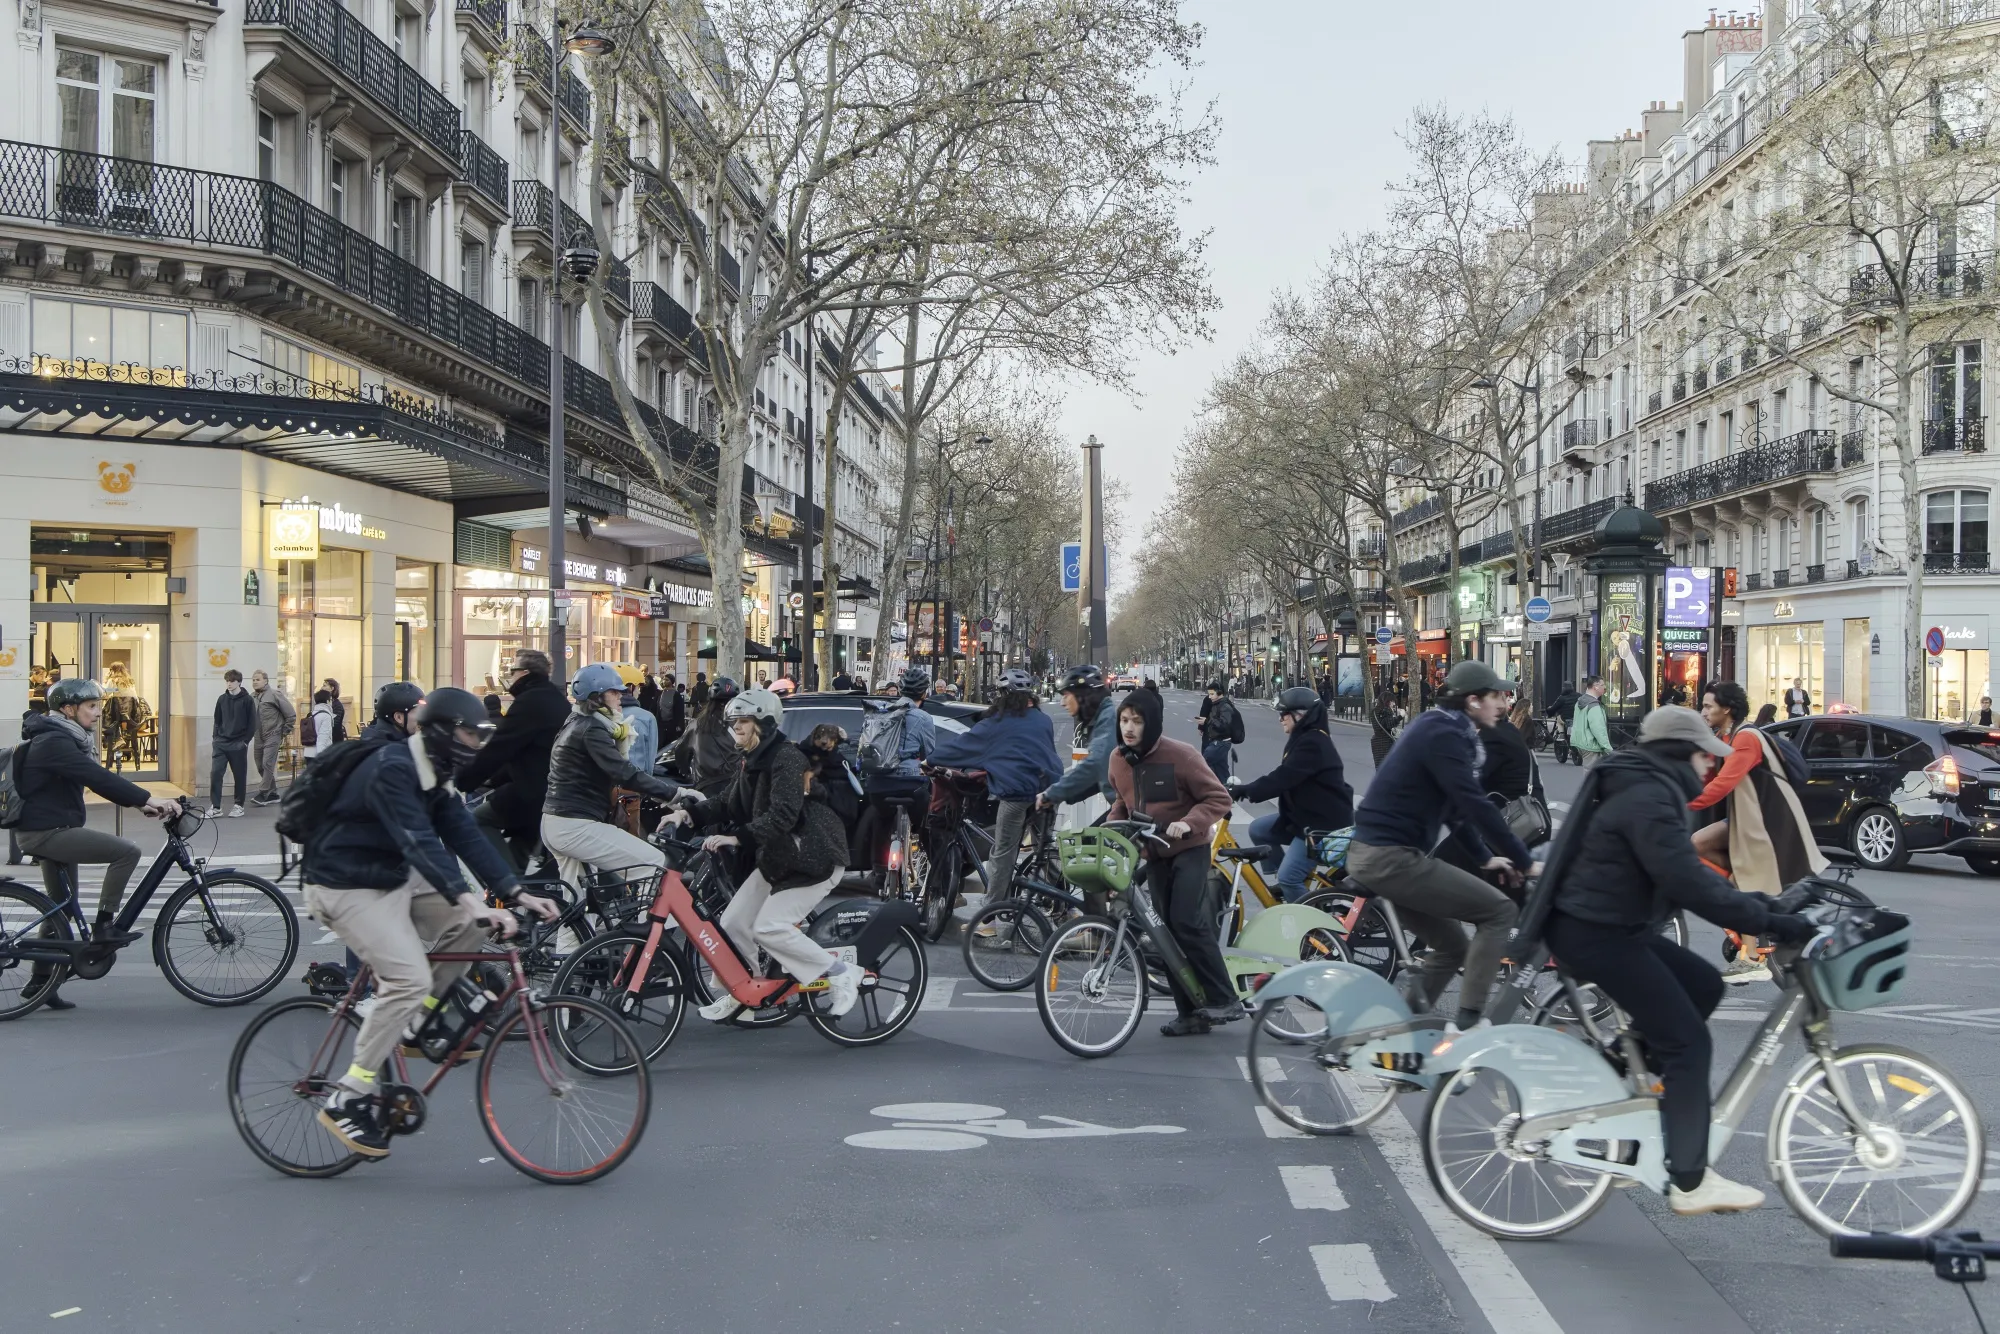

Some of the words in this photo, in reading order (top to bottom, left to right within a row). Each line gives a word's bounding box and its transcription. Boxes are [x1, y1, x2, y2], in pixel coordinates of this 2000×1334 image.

[572, 560, 597, 579] DENTAIRE
[663, 581, 697, 606] STARBUCKS
[697, 589, 713, 608] COFFE
[1667, 577, 1693, 610] P
[1664, 631, 1702, 640] OUVERT
[1938, 625, 1976, 639] larks
